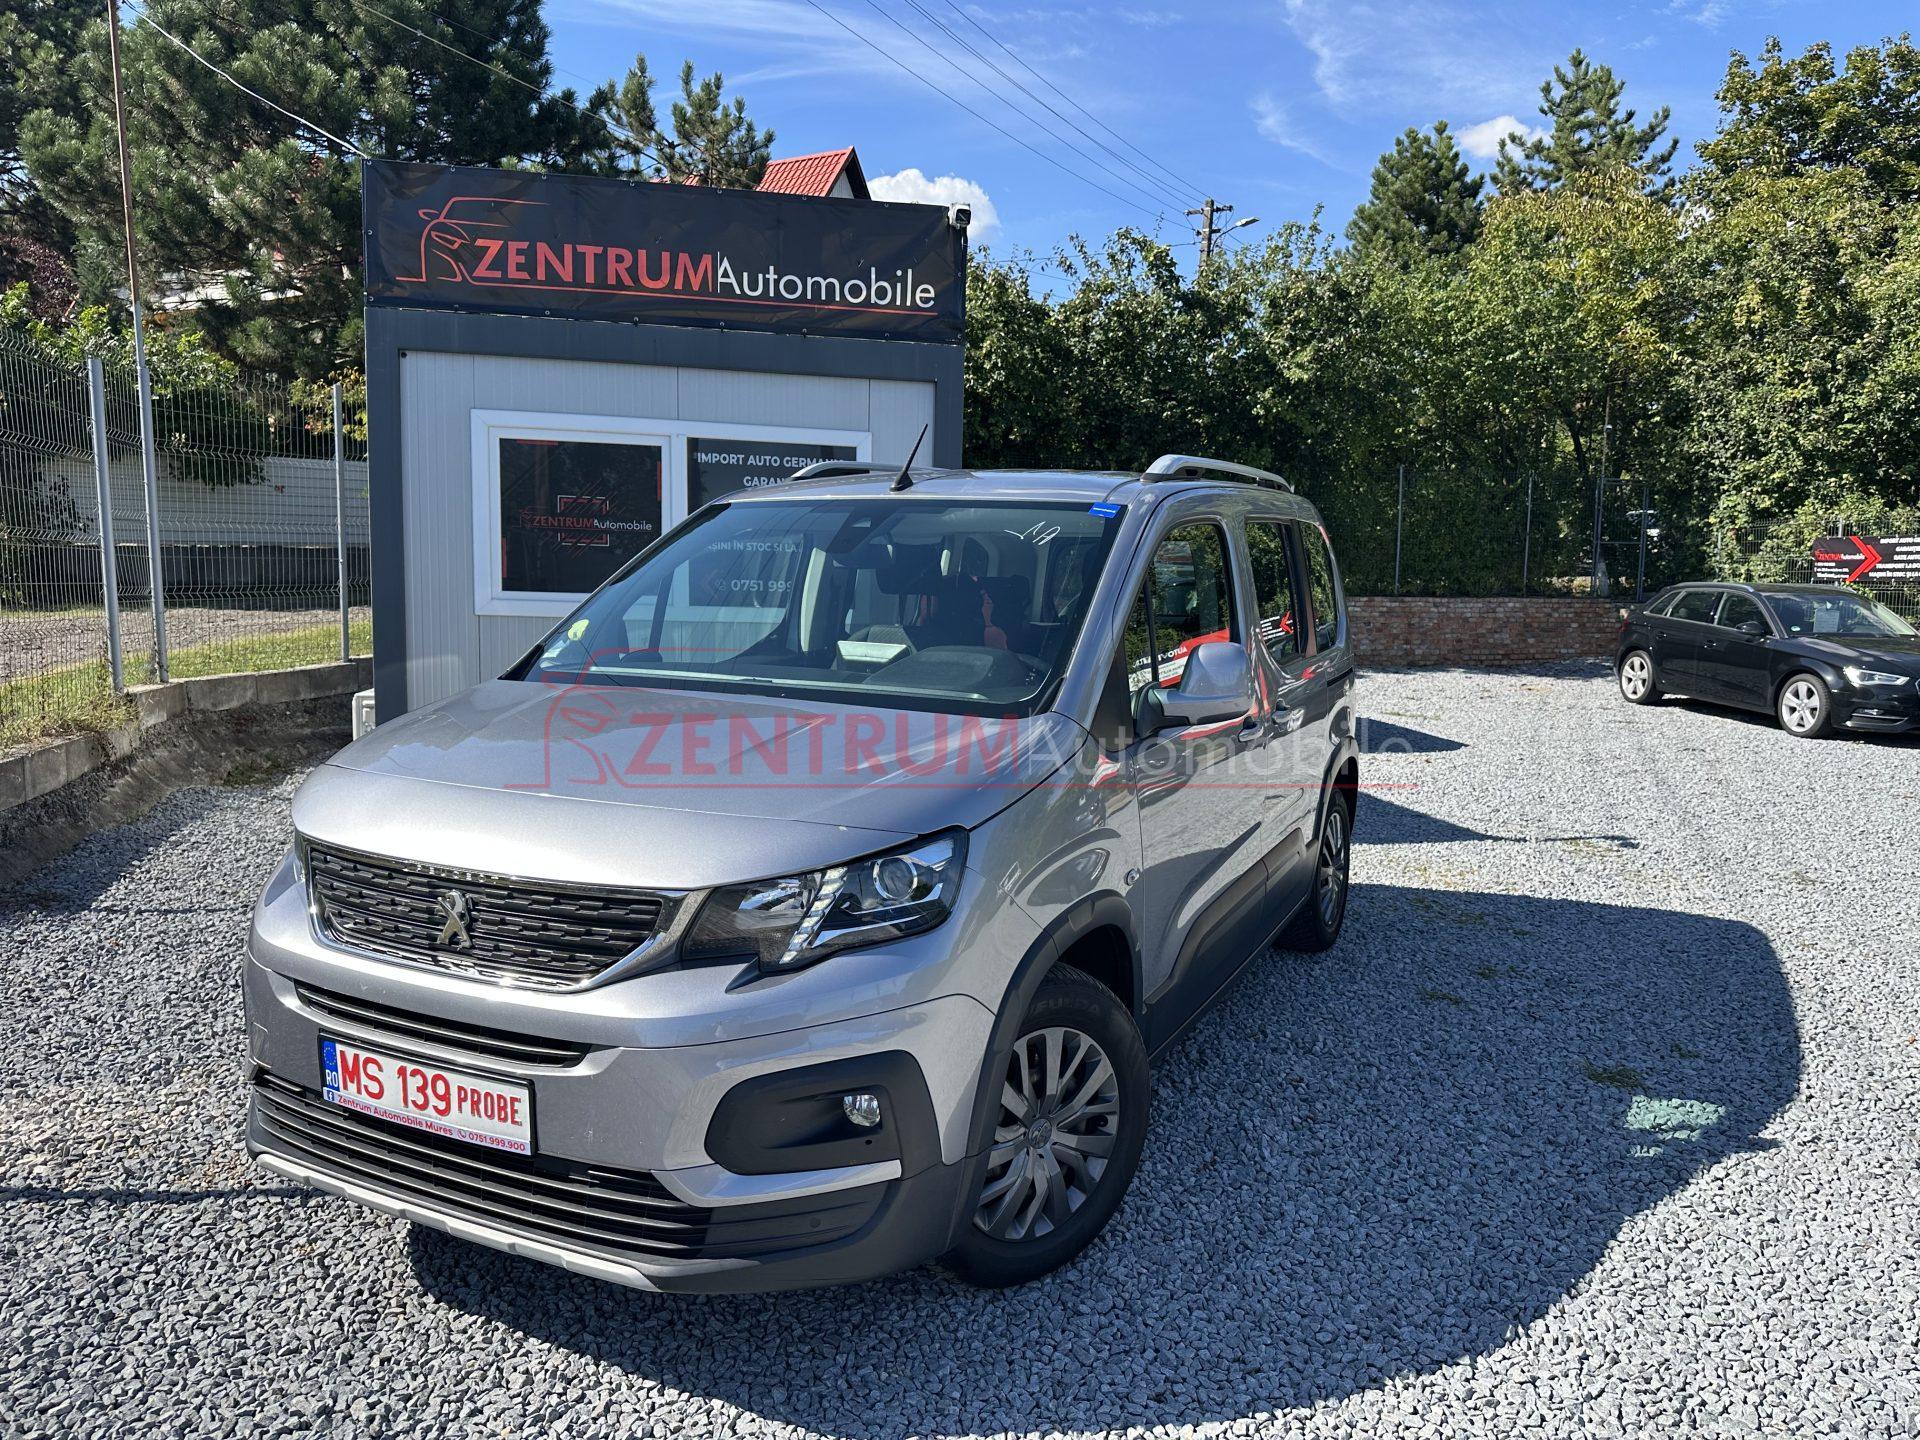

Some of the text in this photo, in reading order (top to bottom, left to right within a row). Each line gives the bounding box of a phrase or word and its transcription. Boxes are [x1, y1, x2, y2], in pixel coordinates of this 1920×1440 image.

[472, 238, 936, 309] ZENTRUM Automobile
[697, 452, 744, 465] IMPORT
[746, 454, 780, 467] AUTO
[533, 516, 652, 531] ZENTRUM Automobile
[746, 543, 772, 552] STOC
[731, 579, 764, 592] 0751
[325, 1069, 339, 1088] RO
[339, 1049, 523, 1127] MS 139 PROBE
[338, 1094, 526, 1152] Zentrum Automobile Mures 0751.999.900
